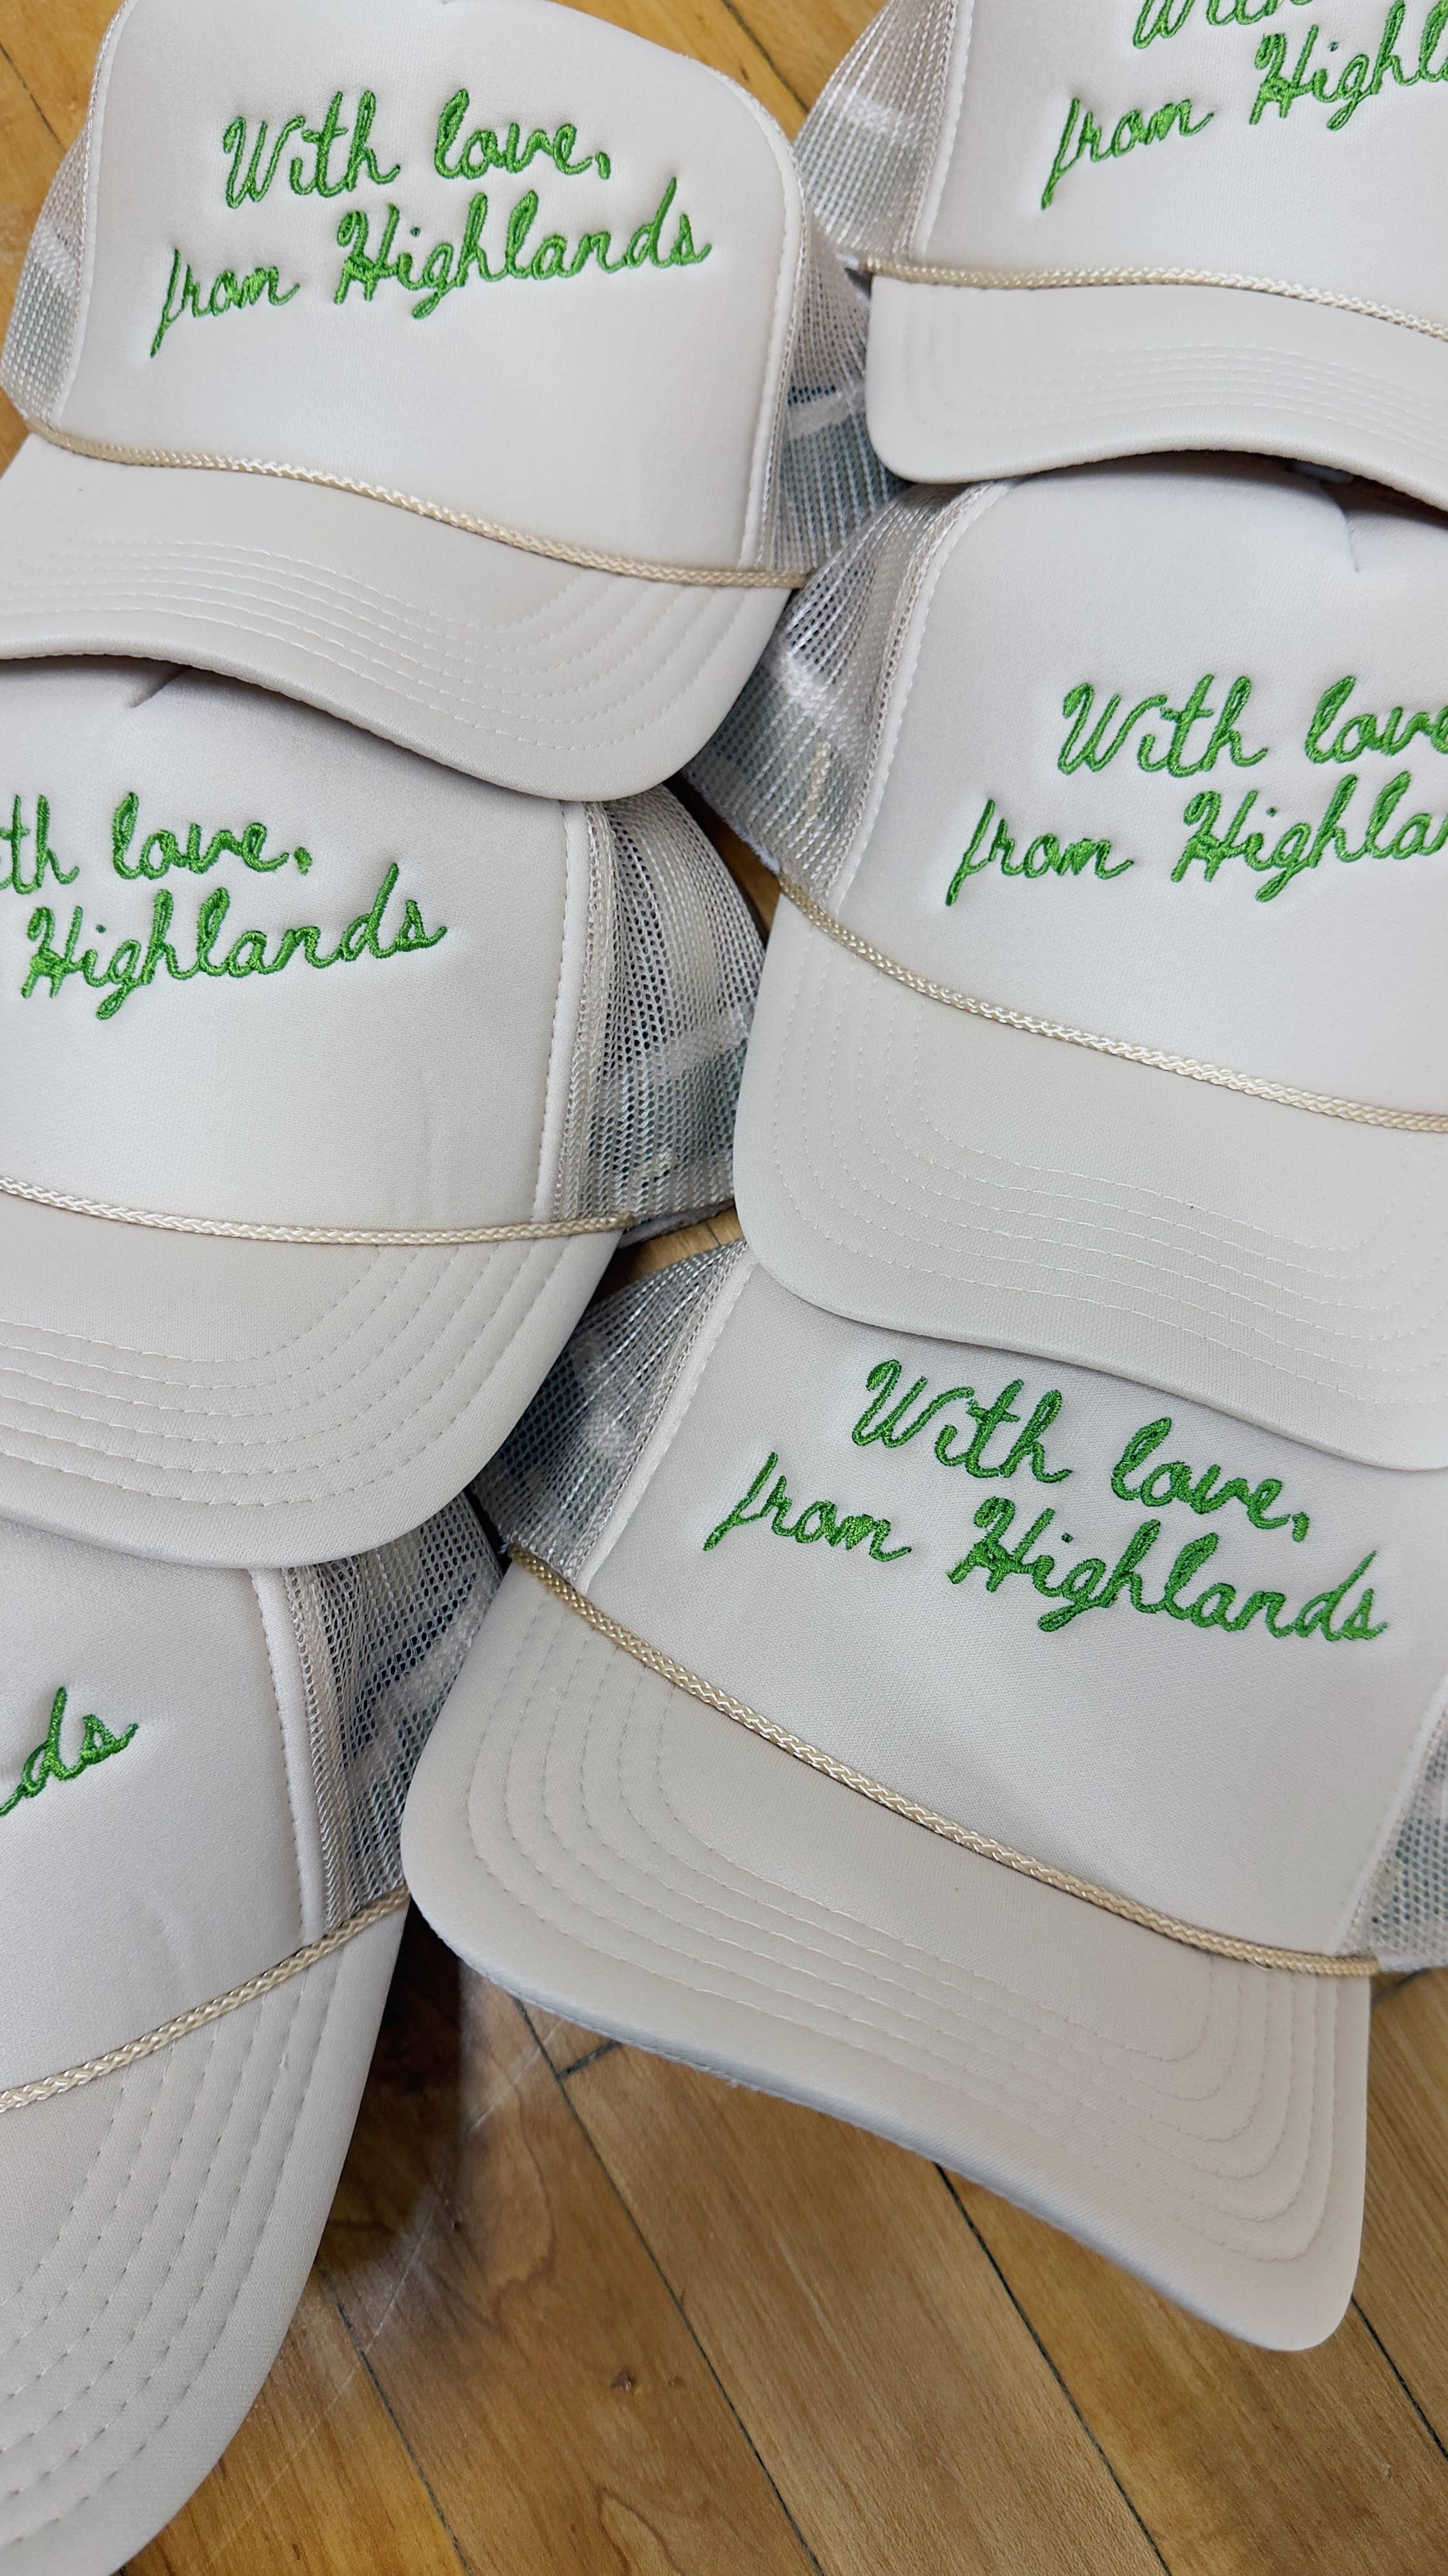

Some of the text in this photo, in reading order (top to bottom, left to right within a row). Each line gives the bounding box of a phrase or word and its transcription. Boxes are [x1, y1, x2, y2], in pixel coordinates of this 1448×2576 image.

[222, 88, 611, 209] With love,
[1041, 0, 1448, 210] from Highl
[150, 177, 712, 358] from Highlands
[1057, 674, 1269, 778] With
[945, 770, 1448, 907] from Highla
[21, 862, 448, 1021] Highlands
[851, 1358, 1310, 1543] With love,
[702, 1450, 1390, 1643] from Highlands
